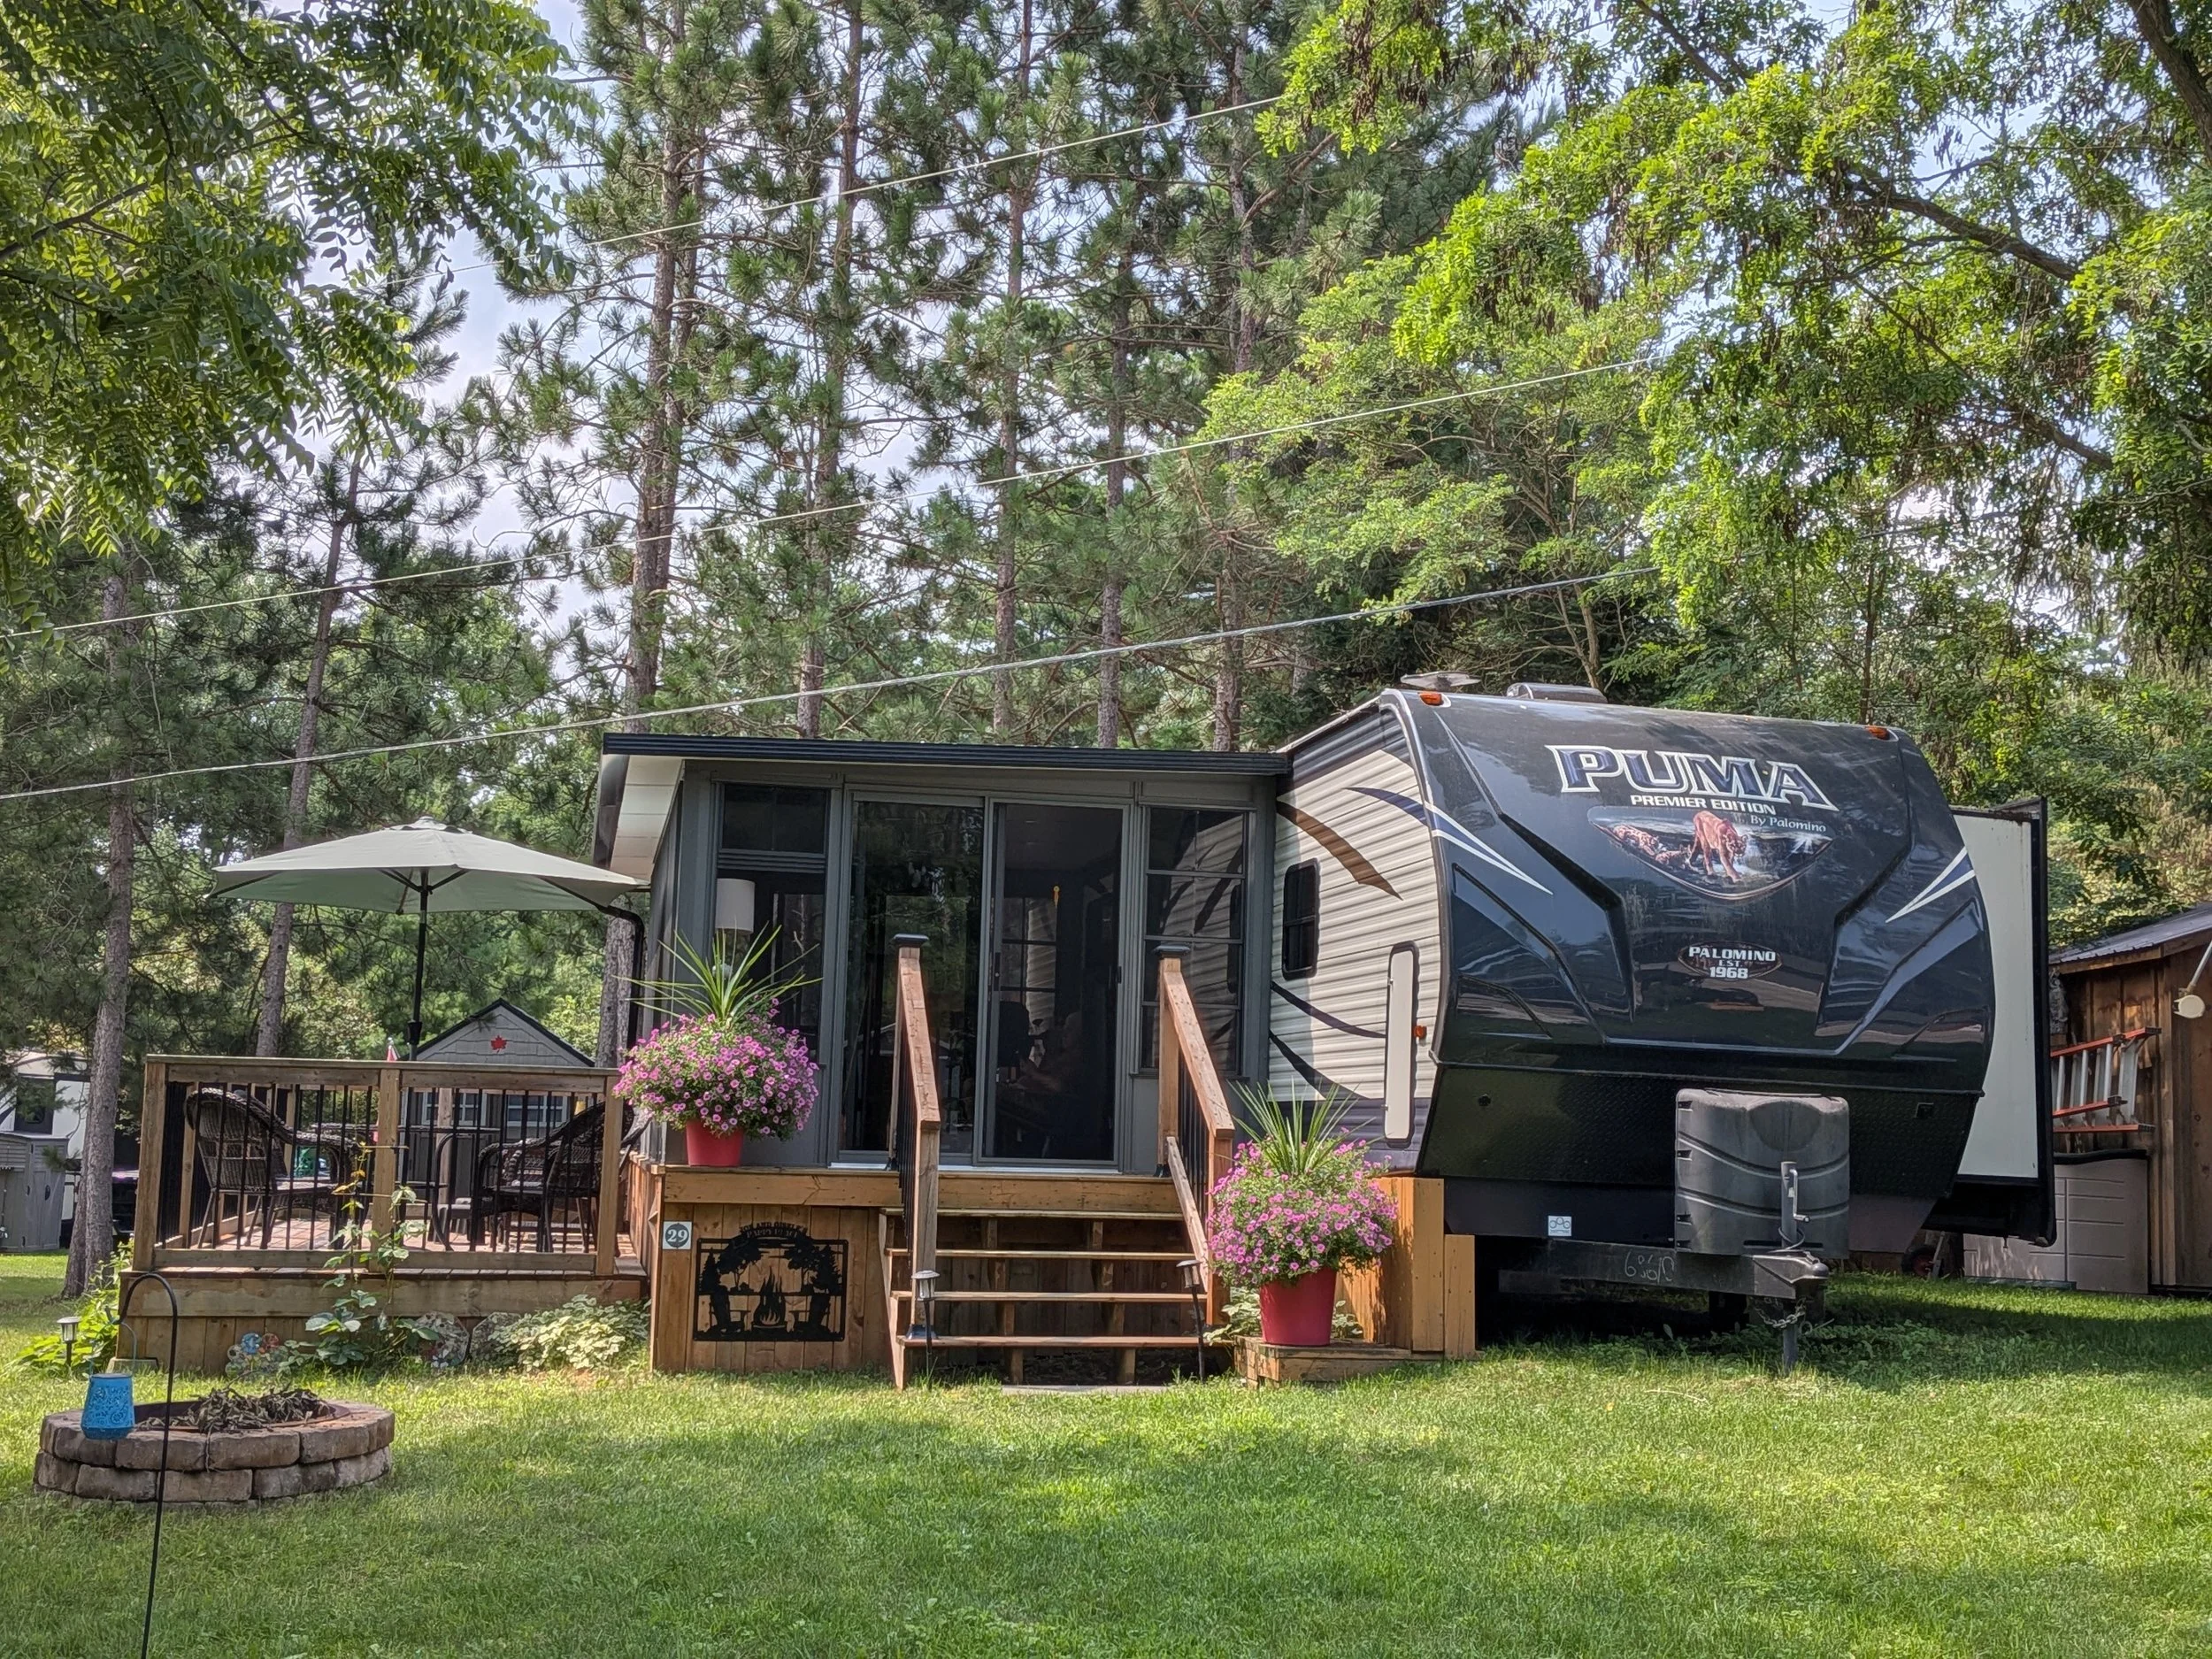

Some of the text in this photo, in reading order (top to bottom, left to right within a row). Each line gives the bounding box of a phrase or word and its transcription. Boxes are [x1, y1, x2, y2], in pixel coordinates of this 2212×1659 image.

[1544, 745, 1839, 811] PUMA
[1630, 795, 1777, 815] PREMIER EDITION
[1750, 816, 1826, 833] By Palomino
[1688, 946, 1776, 962] PALOMINO
[1709, 966, 1748, 979] 1968
[667, 1229, 689, 1241] 29
